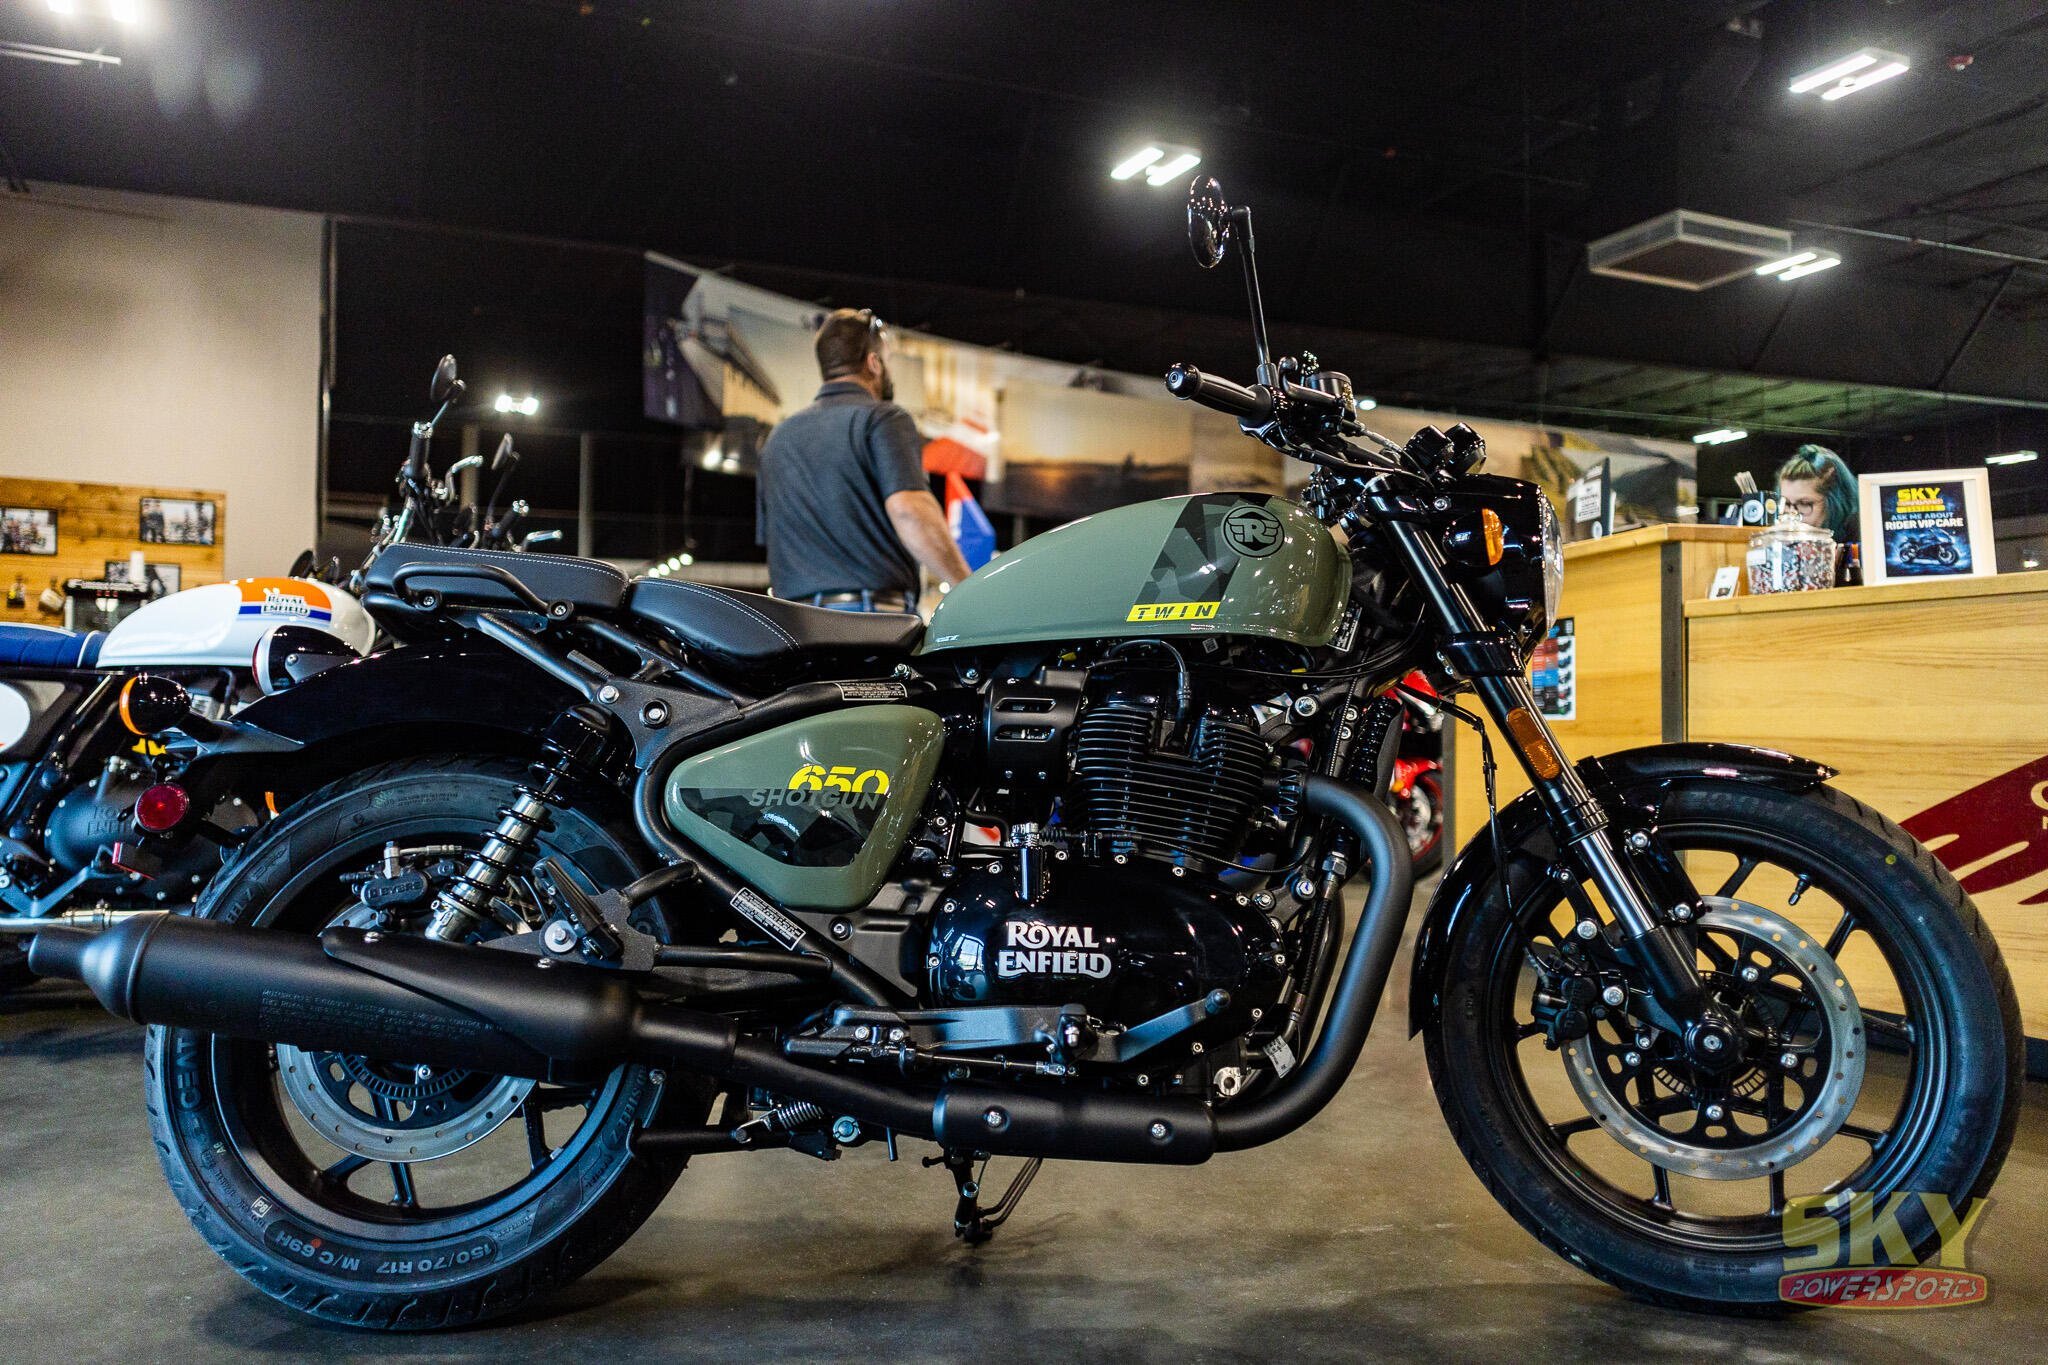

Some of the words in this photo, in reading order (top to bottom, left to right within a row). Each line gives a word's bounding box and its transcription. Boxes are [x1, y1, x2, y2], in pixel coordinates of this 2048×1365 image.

[1897, 487, 1941, 501] SKY
[1885, 520, 1918, 530] RIDER
[1918, 519, 1936, 529] VIP
[1935, 517, 1965, 528] CARE
[1924, 511, 1954, 519] ABOUT
[1137, 604, 1213, 620] TWIN
[788, 765, 890, 794] 650
[749, 788, 880, 811] SHOTGUN
[1007, 920, 1100, 949] ROYAL
[998, 950, 1112, 979] ENFIELD
[176, 1037, 200, 1110] CEAT
[318, 1251, 361, 1272] M/C
[376, 1260, 413, 1275] R17
[418, 1242, 492, 1273] 150/70
